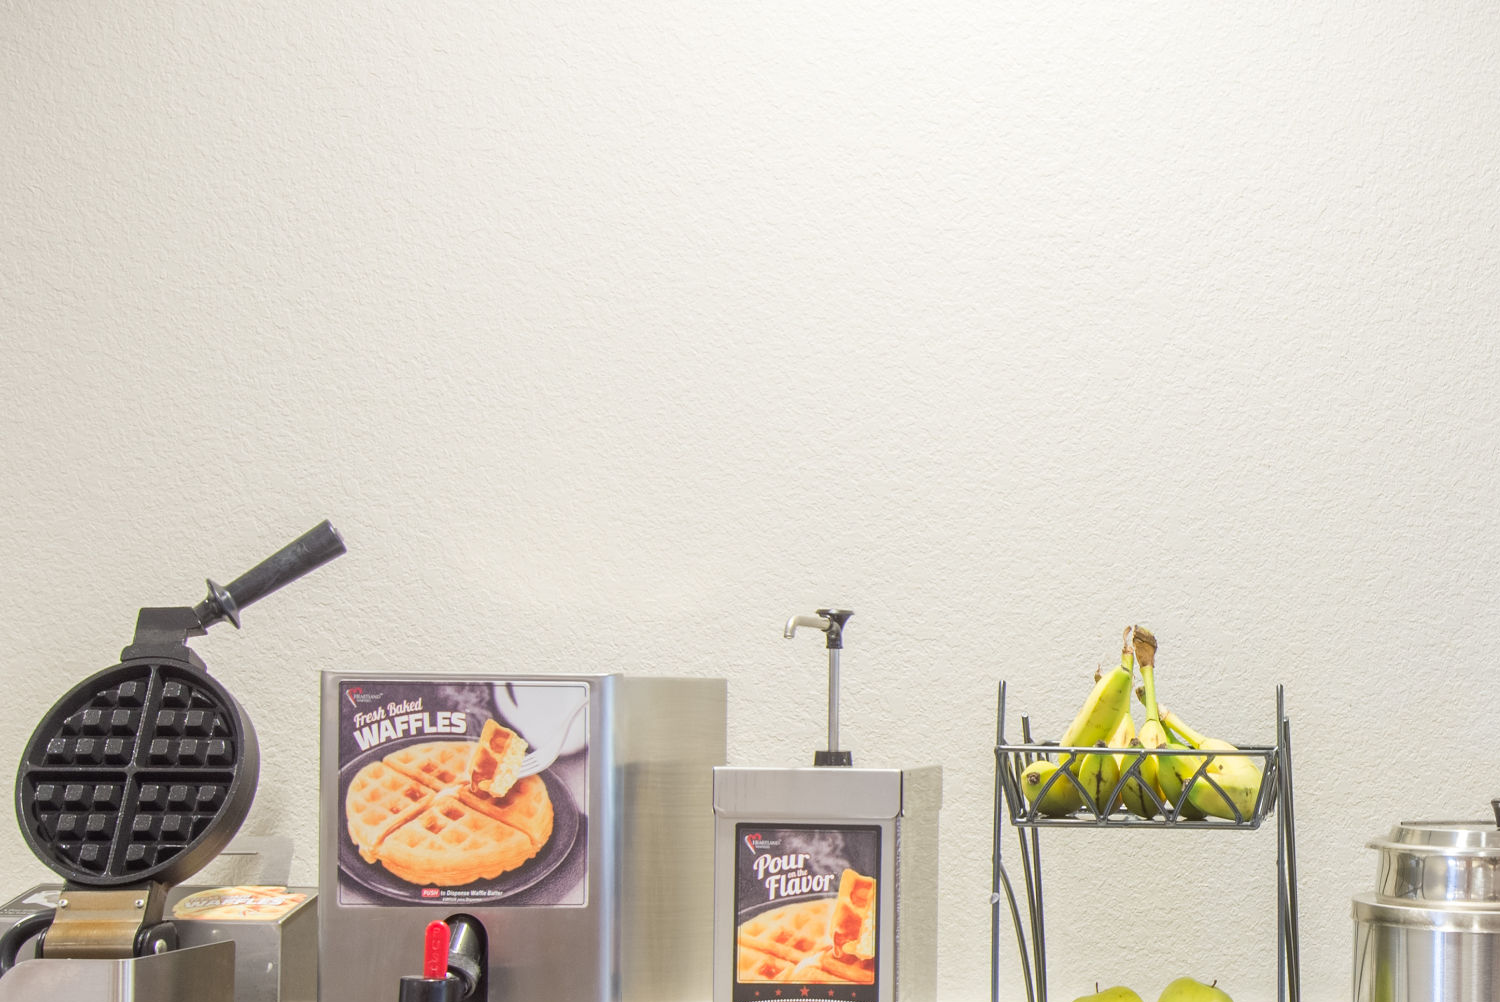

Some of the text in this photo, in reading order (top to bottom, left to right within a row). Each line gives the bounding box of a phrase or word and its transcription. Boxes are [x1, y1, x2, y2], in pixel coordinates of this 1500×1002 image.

[354, 697, 424, 728] Fresh Baked
[353, 711, 467, 752] WAFFLES
[753, 853, 810, 880] Pour
[797, 869, 808, 877] the
[765, 874, 835, 901] Flavor
